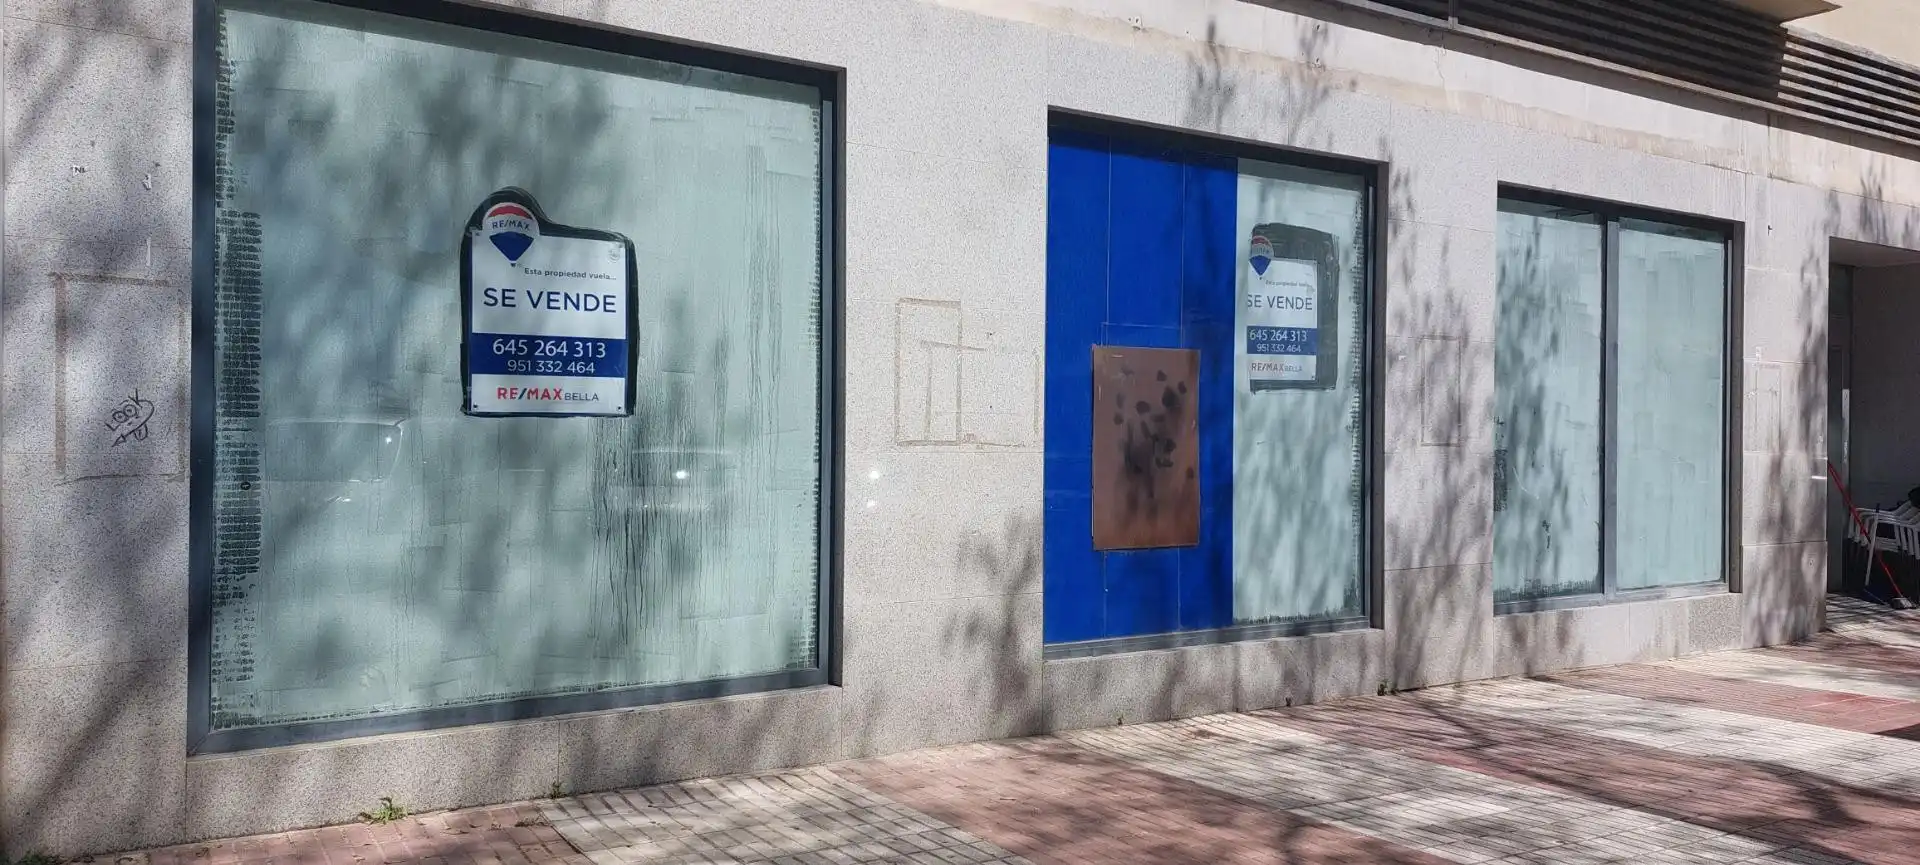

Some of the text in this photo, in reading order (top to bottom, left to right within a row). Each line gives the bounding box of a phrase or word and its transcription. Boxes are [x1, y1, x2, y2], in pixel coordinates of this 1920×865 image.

[492, 219, 530, 231] RE/MAX
[524, 267, 542, 276] Esta
[544, 268, 587, 279] propiedad
[483, 287, 617, 313] SE VENDE
[1267, 296, 1313, 310] VENDE
[1250, 328, 1307, 342] 645 264 313
[492, 338, 606, 358] 645 264 313
[1256, 343, 1301, 353] 951 332 464
[507, 359, 595, 374] 951 332 464
[1251, 362, 1284, 372] RE/MAX
[497, 387, 599, 401] RE/MAX BELLA
